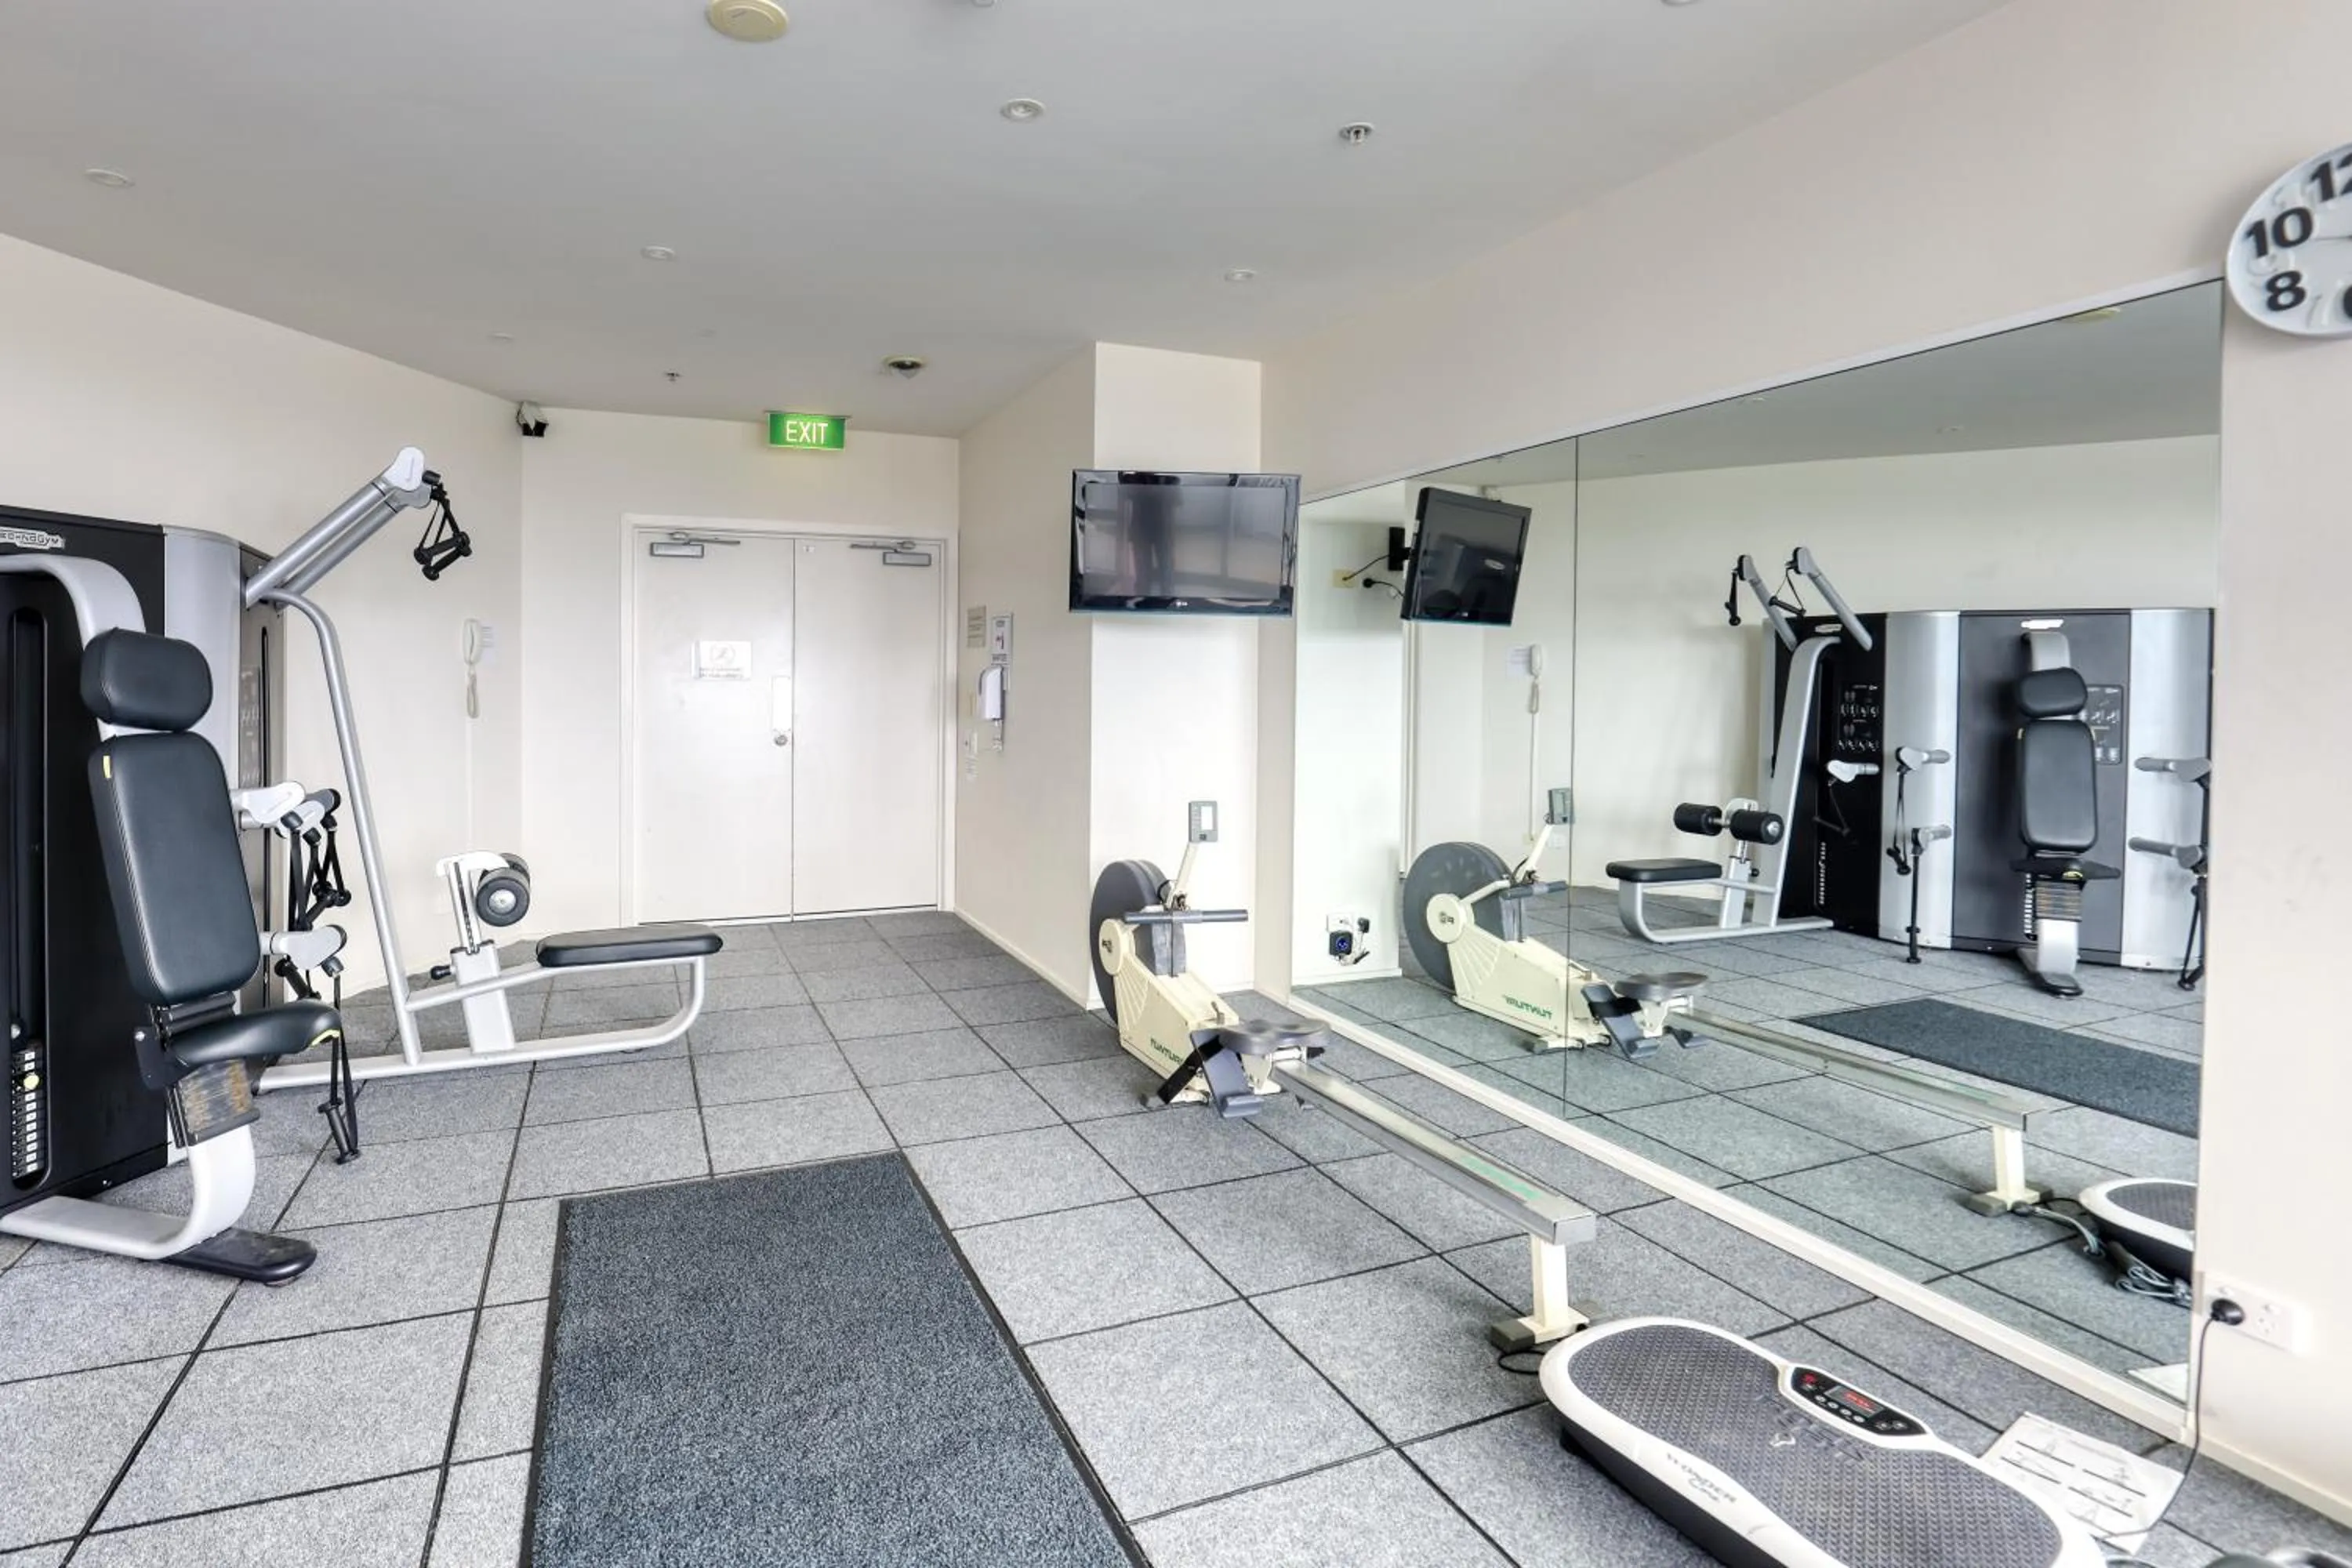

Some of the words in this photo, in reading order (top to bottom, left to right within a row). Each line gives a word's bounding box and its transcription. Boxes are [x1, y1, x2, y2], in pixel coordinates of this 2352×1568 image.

[2245, 207, 2314, 258] 10
[2266, 270, 2306, 311] 8
[786, 420, 828, 445] EXIT
